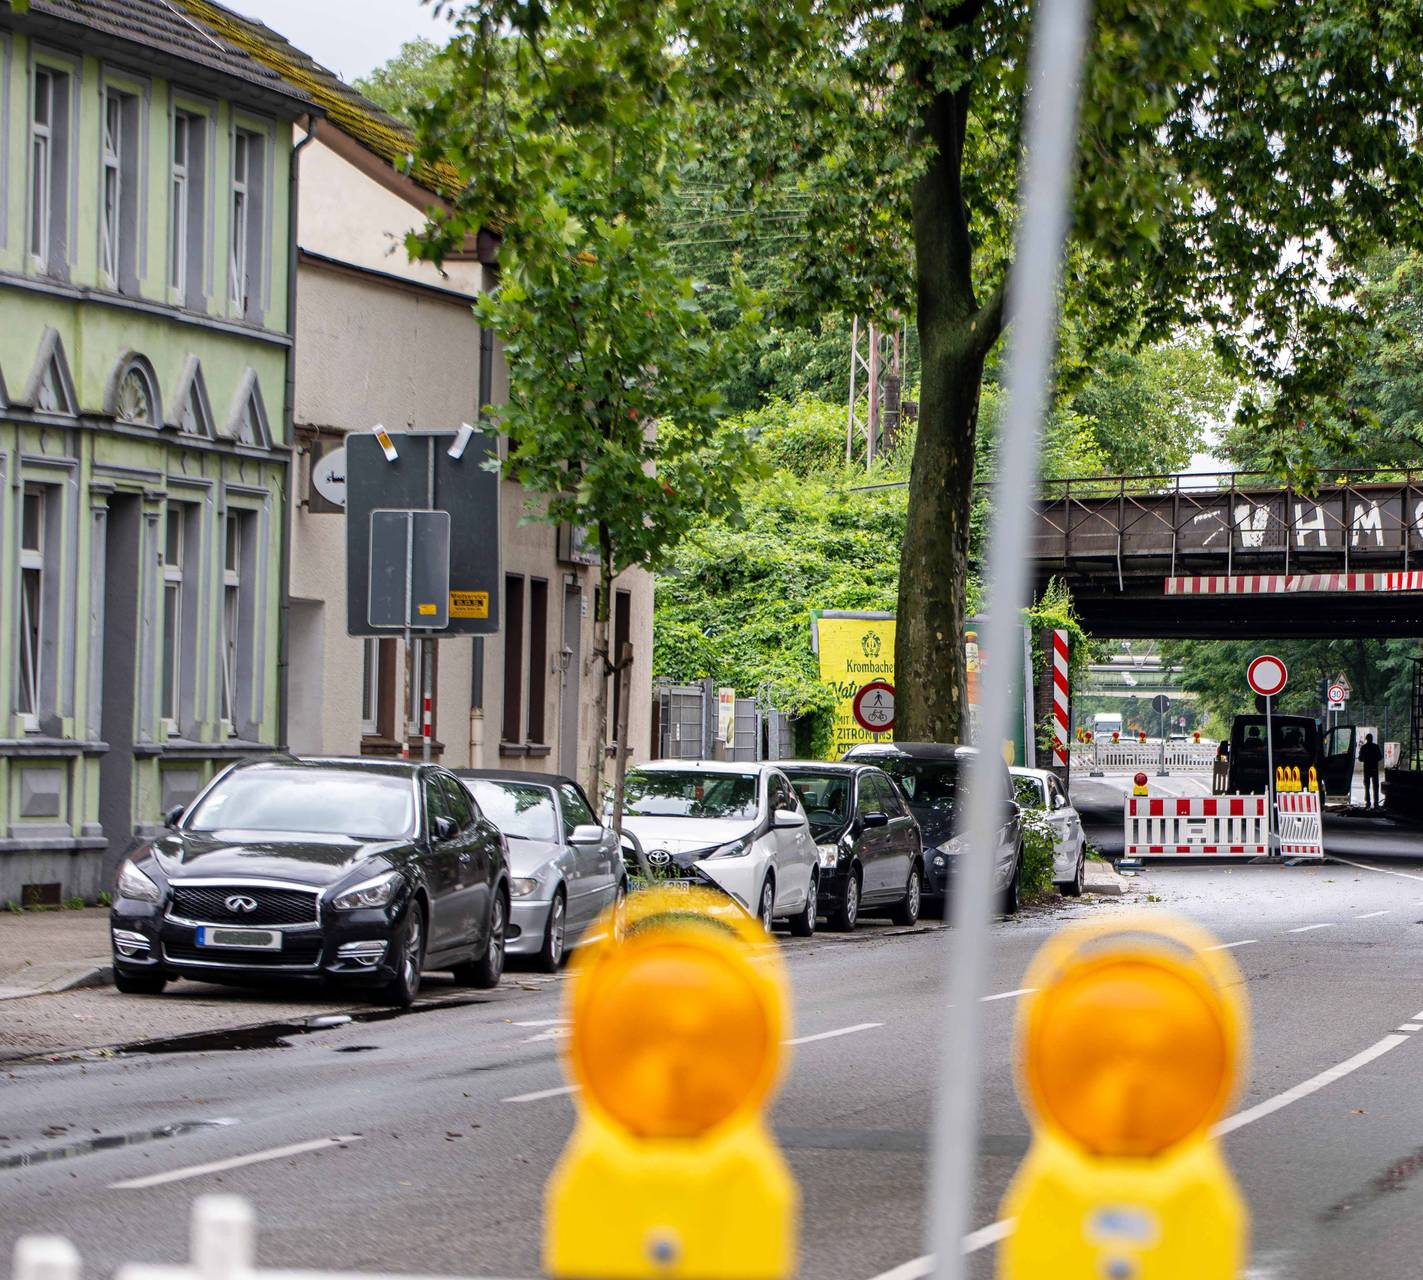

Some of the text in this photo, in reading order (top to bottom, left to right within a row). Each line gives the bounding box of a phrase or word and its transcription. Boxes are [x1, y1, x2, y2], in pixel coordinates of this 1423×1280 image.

[846, 659, 894, 673] Krombache
[1331, 690, 1341, 698] 30
[836, 728, 893, 740] ZITRONNS
